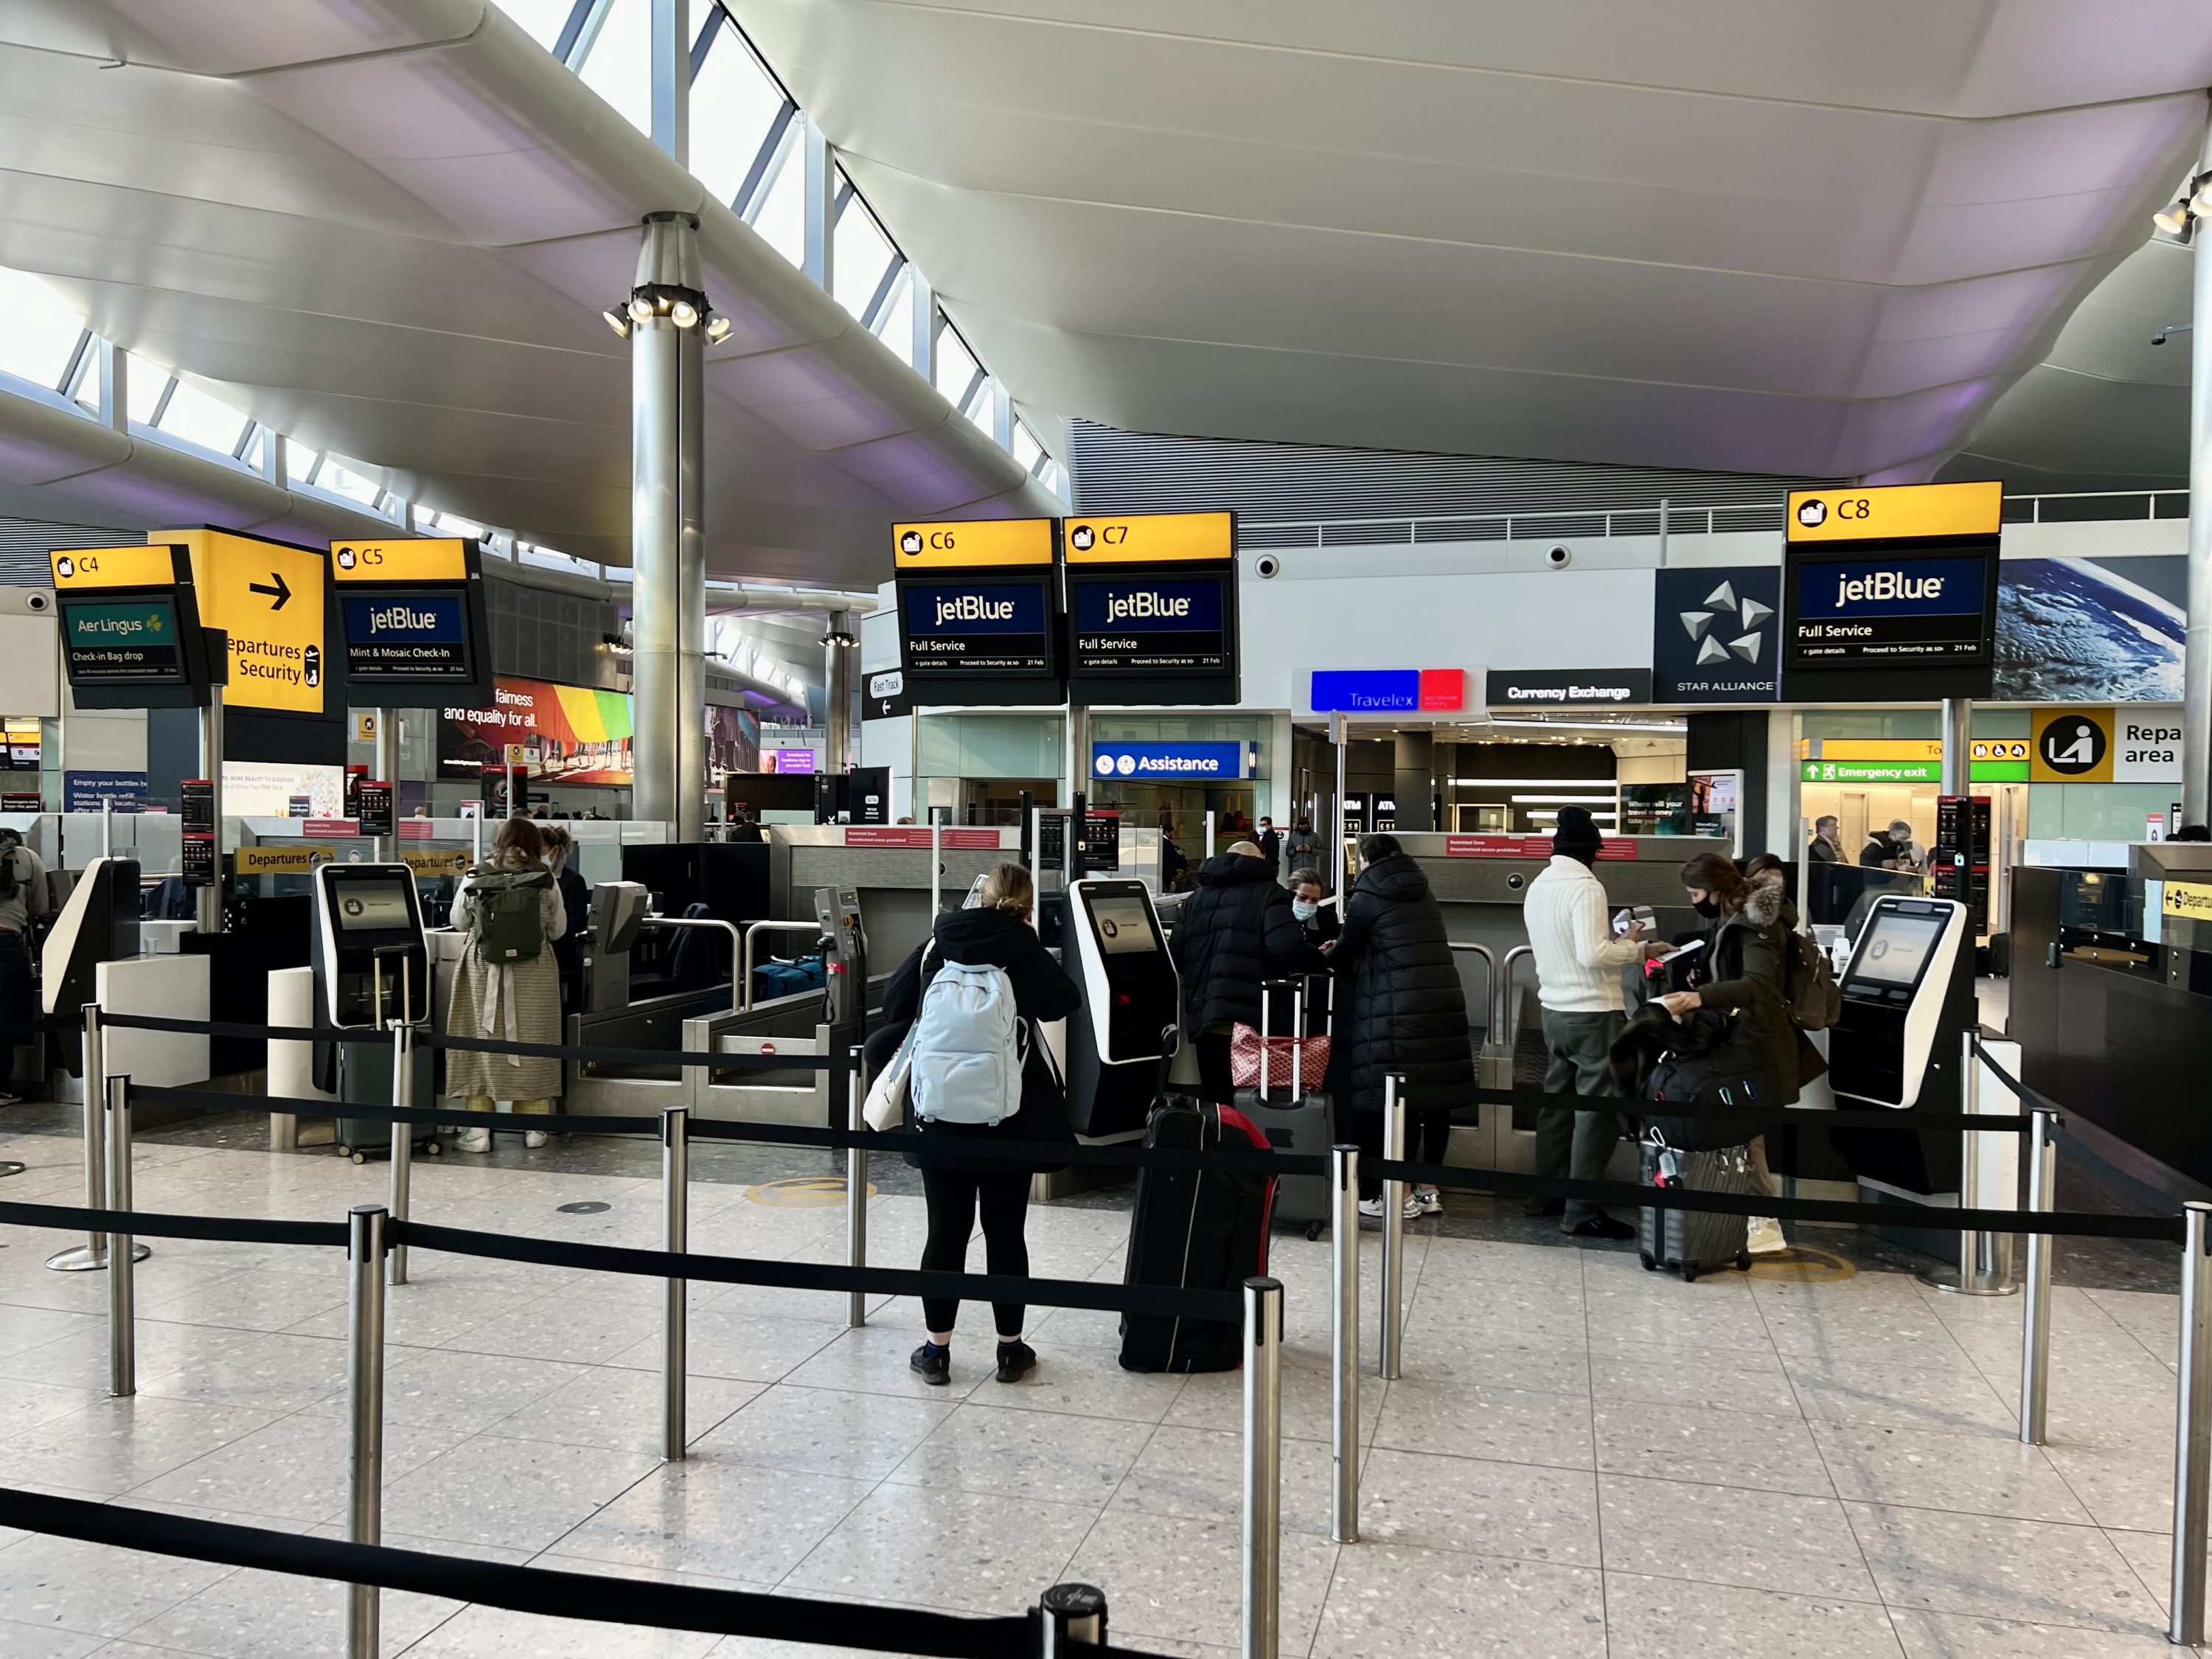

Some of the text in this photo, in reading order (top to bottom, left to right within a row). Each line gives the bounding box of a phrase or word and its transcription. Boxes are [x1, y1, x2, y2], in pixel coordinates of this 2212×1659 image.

[1837, 499, 1870, 520] C8
[930, 532, 955, 549] C6
[1102, 526, 1128, 544] C7
[79, 557, 99, 572] C4
[362, 549, 383, 565] C5
[1835, 571, 1942, 608] jetBlue
[936, 595, 1013, 625] jetBlue
[1107, 592, 1189, 623] jetBlue
[77, 619, 142, 636] Aer Lingus
[370, 607, 437, 634] jetBlue
[1798, 625, 1873, 637] Full Service
[228, 638, 301, 659] epartures
[910, 641, 966, 651] Full Service
[1079, 638, 1138, 649] Full Service
[72, 651, 144, 662] Check-in Bag drop
[349, 647, 451, 658] Mint & Mosaic Check-In
[240, 659, 302, 686] Security
[874, 678, 899, 692] Fast Track
[1677, 681, 1774, 692] STAR ALLIANCE
[495, 688, 534, 707] fairness
[1349, 692, 1413, 707] Travelex
[1508, 686, 1631, 701] Currency Exchange
[444, 707, 538, 728] and equality for all.
[2126, 725, 2182, 745] Repa
[1927, 745, 1942, 755] To
[2125, 750, 2174, 762] area
[1138, 756, 1219, 771] Assistance
[1838, 767, 1927, 779] Emergency exit
[248, 853, 307, 868] Departures
